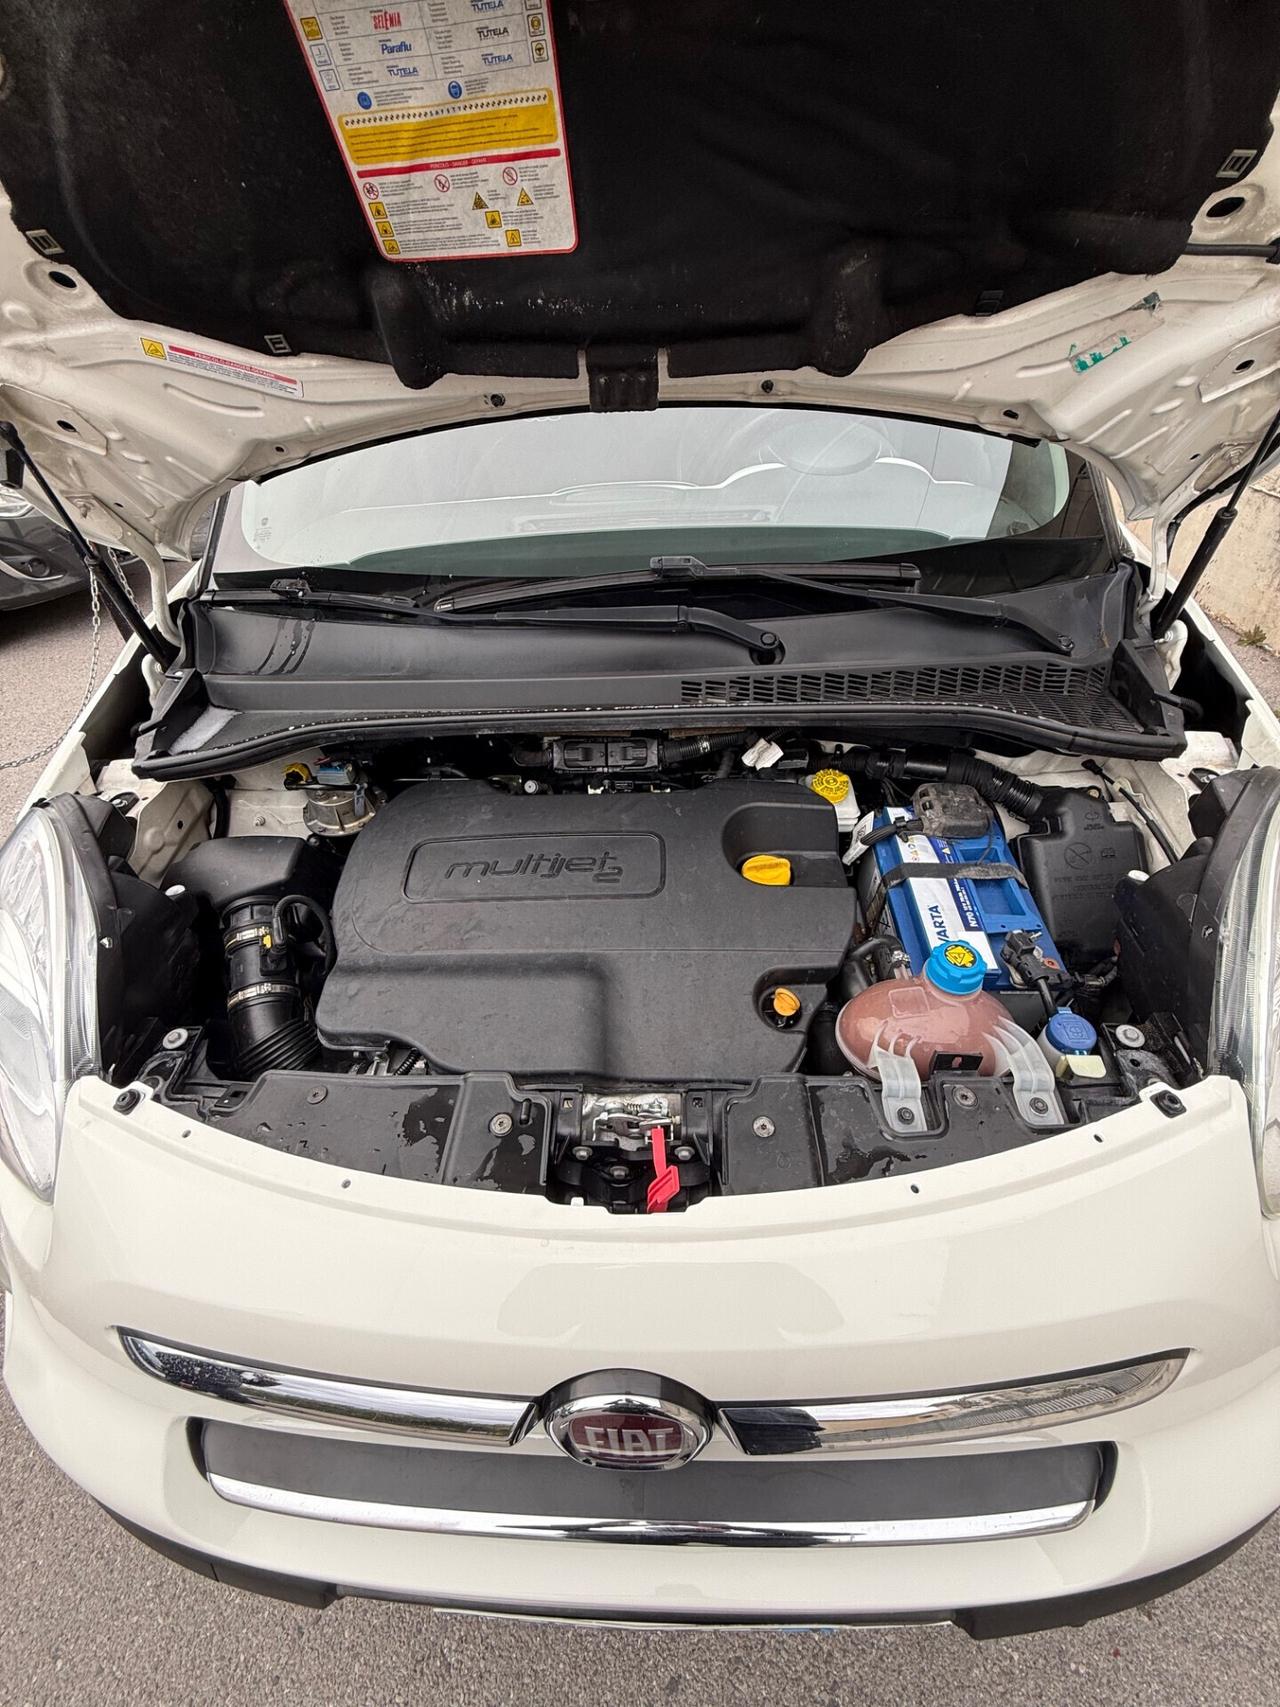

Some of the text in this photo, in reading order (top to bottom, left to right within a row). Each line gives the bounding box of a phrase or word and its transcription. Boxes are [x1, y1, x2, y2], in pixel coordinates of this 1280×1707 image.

[472, 1, 504, 11] TUTELA
[477, 27, 509, 38] TUTELA
[381, 41, 412, 54] Paraflu
[482, 54, 513, 65] TUTELA
[387, 67, 419, 77] TUTELA
[444, 850, 623, 884] multijet 2
[584, 1425, 675, 1455] FIAT
